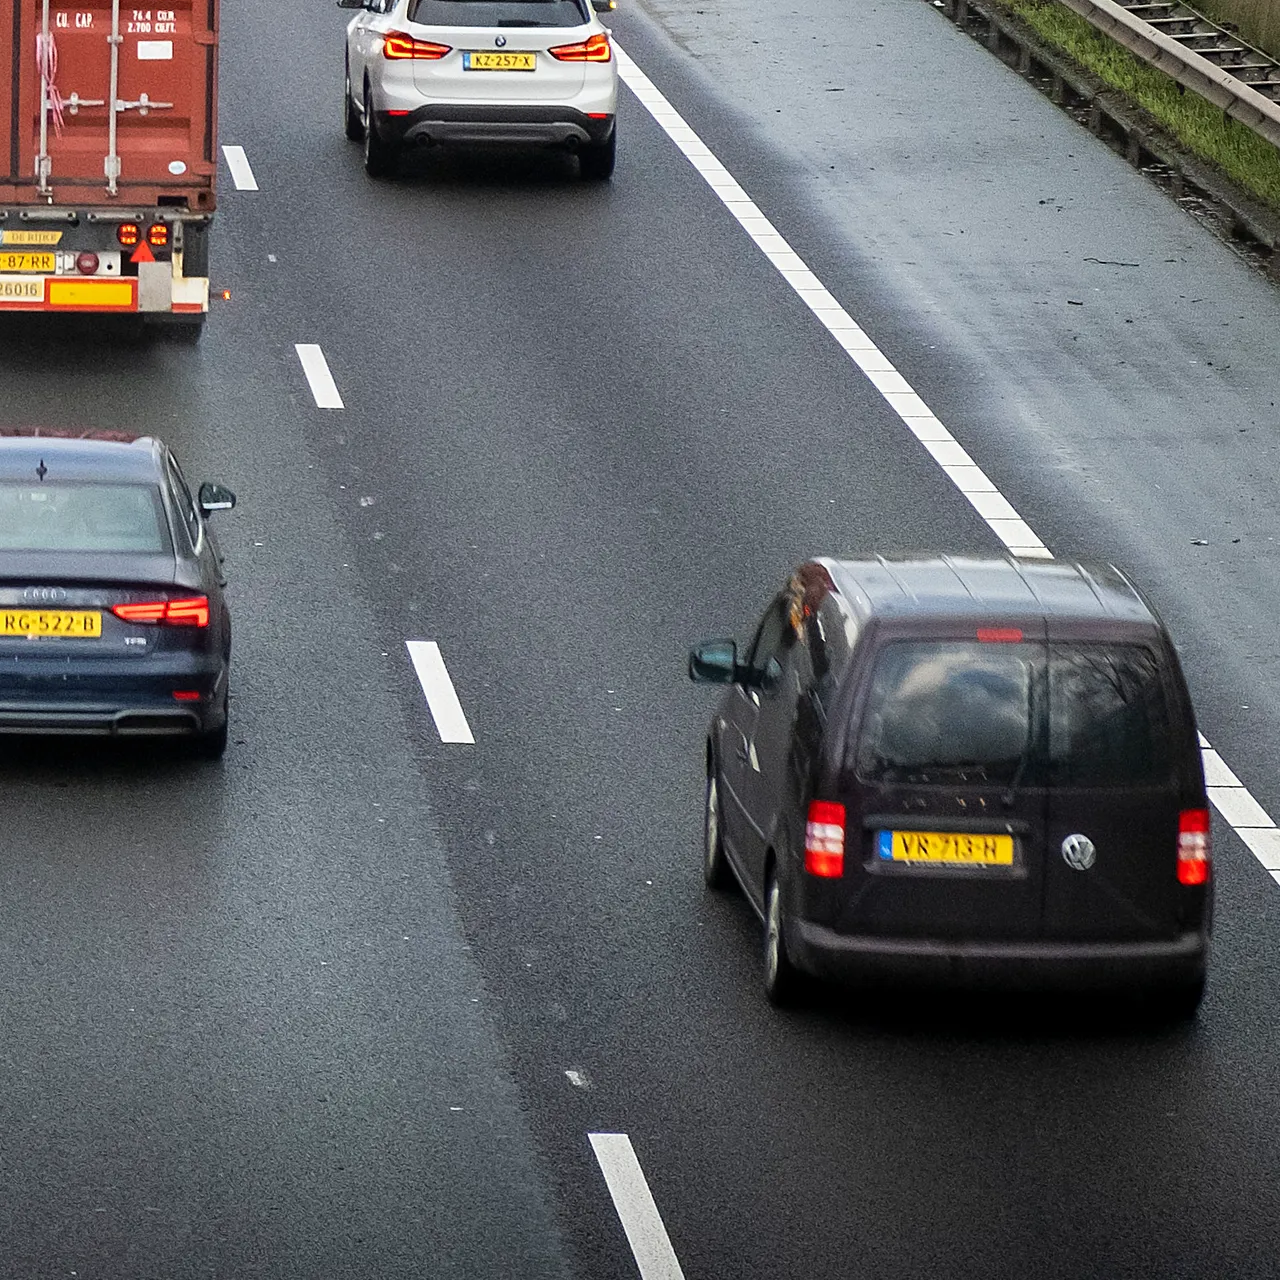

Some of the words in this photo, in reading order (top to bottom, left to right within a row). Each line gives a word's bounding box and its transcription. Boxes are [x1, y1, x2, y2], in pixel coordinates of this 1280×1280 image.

[75, 13, 94, 28] CAP.
[133, 10, 151, 20] 76.4
[128, 23, 151, 33] 2.700
[475, 55, 531, 68] KZ-257-X
[11, 233, 25, 241] DE
[4, 613, 94, 632] RG-522-B
